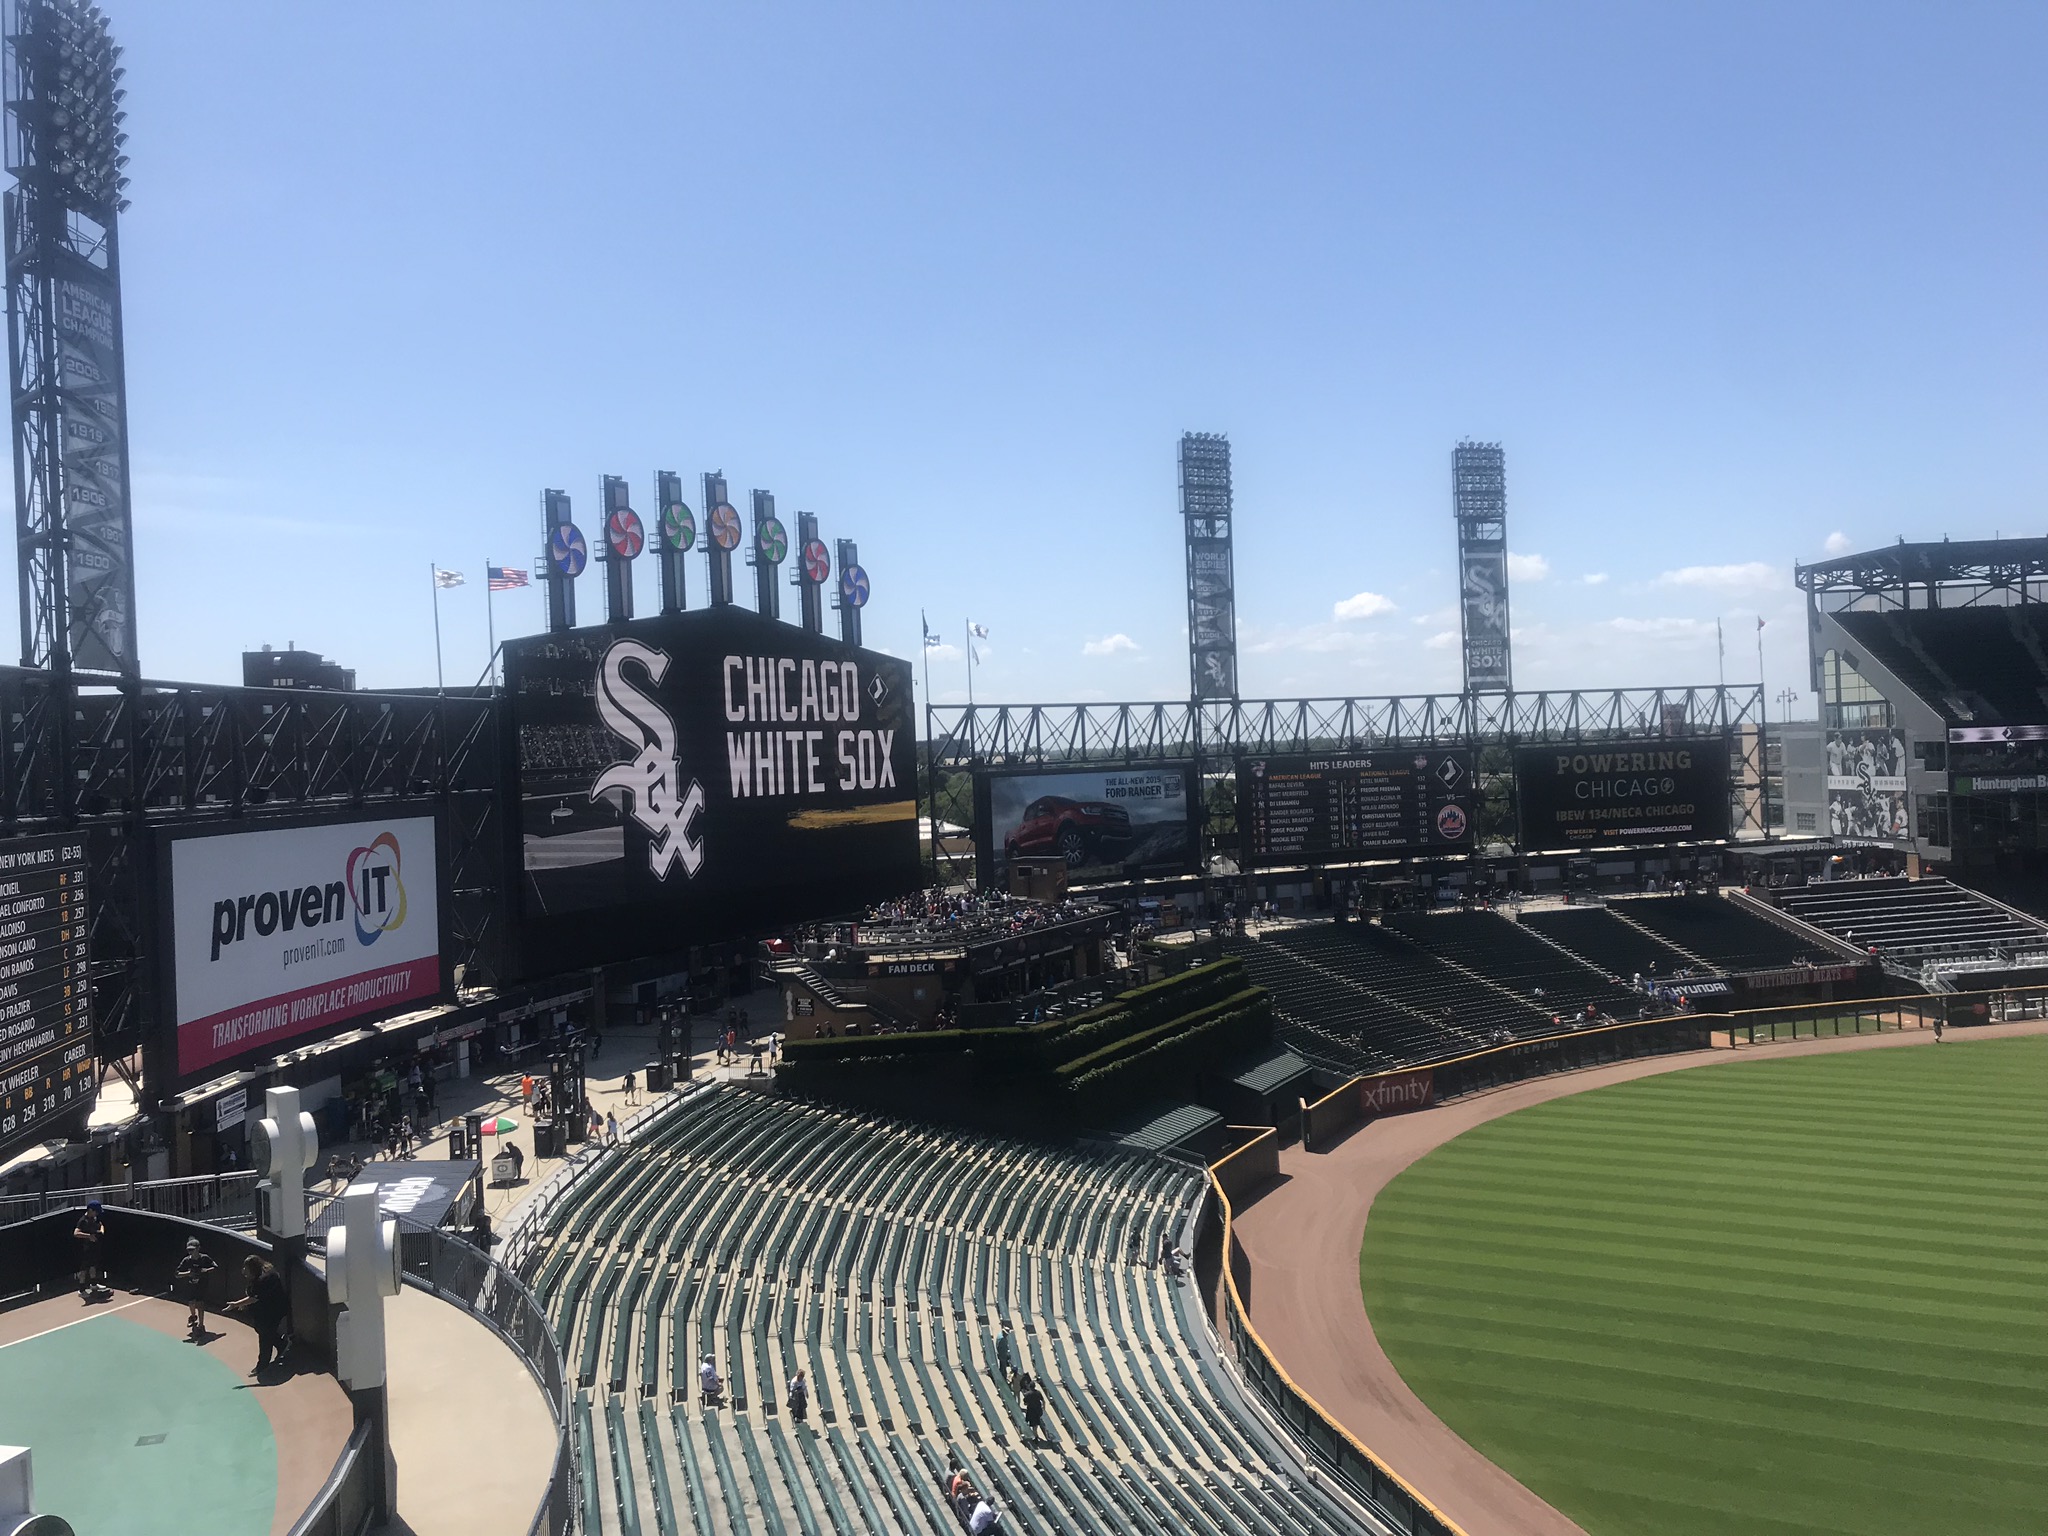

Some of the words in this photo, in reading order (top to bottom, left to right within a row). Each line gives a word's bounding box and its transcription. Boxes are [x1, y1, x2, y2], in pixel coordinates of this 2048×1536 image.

[62, 280, 112, 316] AMERICAN
[62, 296, 113, 336] LEAGUE
[62, 318, 114, 351] CHAMPIONS
[66, 360, 100, 380] 2005
[70, 424, 103, 442] 1919
[96, 461, 119, 479] 1917
[72, 488, 106, 506] 1906
[77, 553, 110, 569] 1900
[1195, 552, 1226, 561] WORLD
[1196, 560, 1226, 569] SERIES
[1471, 655, 1502, 668] SOX
[723, 655, 860, 722] CHICAGO
[726, 730, 826, 798] WHITE
[838, 729, 897, 791] SOX
[1310, 761, 1330, 770] HITS
[1332, 760, 1372, 769] LEADERS
[1556, 750, 1692, 774] POWERING
[1105, 778, 1116, 786] THE
[1118, 777, 1144, 786] ALL-NEW
[1105, 788, 1126, 798] FORD
[1128, 785, 1162, 797] RANGER
[1575, 778, 1674, 799] CHICAGO
[1972, 777, 2036, 792] Huntington
[1556, 810, 1585, 822] IBEW
[1590, 806, 1643, 820] 134/NECA
[1646, 804, 1694, 816] CHICAGO
[1619, 824, 1692, 835] POWERINGCHICAGO.COM
[0, 854, 16, 869] NEW
[17, 851, 36, 866] YORK
[37, 849, 54, 864] METS
[62, 845, 82, 861] (52-55)
[60, 874, 67, 885] RF
[73, 871, 83, 883] .331
[12, 897, 45, 914] CONFORTO
[60, 892, 68, 904] CF
[73, 889, 84, 902] .256
[0, 921, 26, 938] ALONSO
[62, 910, 68, 922] 1B
[74, 907, 84, 919] .257
[210, 880, 346, 962] proven
[362, 865, 390, 916] IT
[18, 938, 36, 953] CANO
[61, 929, 70, 941] DH
[74, 925, 85, 938] .235
[11, 958, 34, 976] RAMOS
[64, 948, 68, 959] C
[283, 936, 346, 970] provenIT.com
[64, 966, 69, 979] LF
[75, 961, 86, 974] .298
[888, 964, 907, 974] FAN
[910, 963, 935, 972] DECK
[1747, 972, 1809, 989] WHITTINGHAM
[1814, 969, 1841, 981] MEATS
[6, 1000, 30, 1019] FRAZIER
[76, 980, 86, 993] .250
[1672, 982, 1727, 996] HYUNDAI
[8, 1017, 35, 1038] ROSARIO
[64, 1003, 71, 1015] SS
[77, 997, 87, 1011] .274
[212, 1003, 288, 1050] TRANSFORMING
[290, 986, 346, 1024] WORKPLACE
[347, 970, 412, 1007] PRODUCTIVITY
[14, 1030, 55, 1057] HECHAVARRIA
[78, 1015, 88, 1029] .231
[64, 1044, 86, 1064] CAREER
[5, 1097, 11, 1110] H
[24, 1086, 33, 1100] BB
[46, 1077, 51, 1089] R
[63, 1068, 71, 1081] HR
[77, 1058, 91, 1074] WHIP
[8, 1065, 39, 1090] WHEELER
[2, 1114, 16, 1134] 628
[23, 1104, 36, 1123] 254
[43, 1094, 55, 1112] 318
[63, 1085, 72, 1101] 70
[79, 1075, 92, 1092] 1.30
[1365, 1077, 1430, 1111] xfinity
